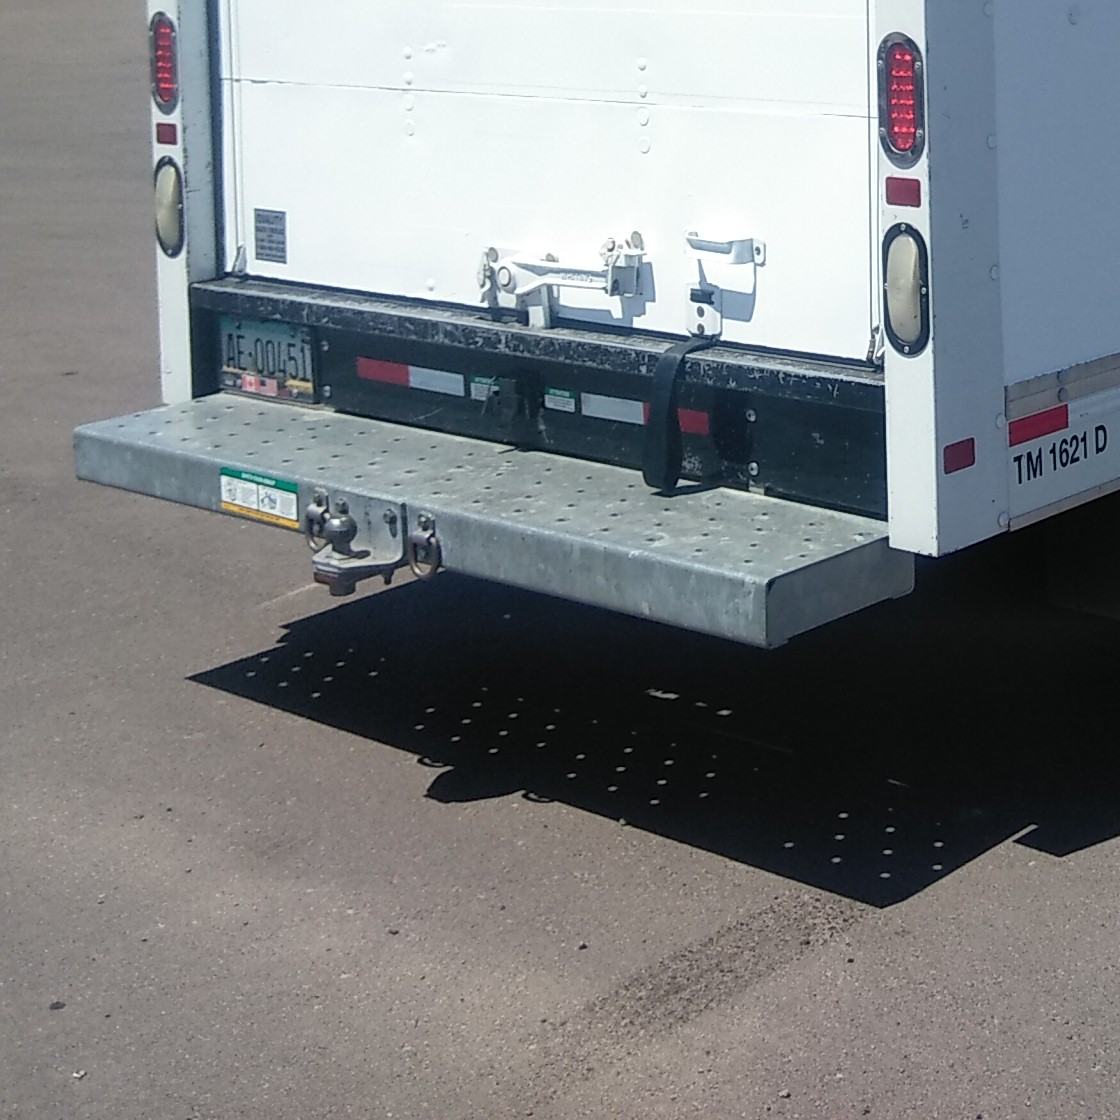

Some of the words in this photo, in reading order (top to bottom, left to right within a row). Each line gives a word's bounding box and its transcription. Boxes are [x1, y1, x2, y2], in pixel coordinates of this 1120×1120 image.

[1013, 447, 1043, 484] TM
[1049, 431, 1087, 471] 1621
[1095, 425, 1108, 454] D
